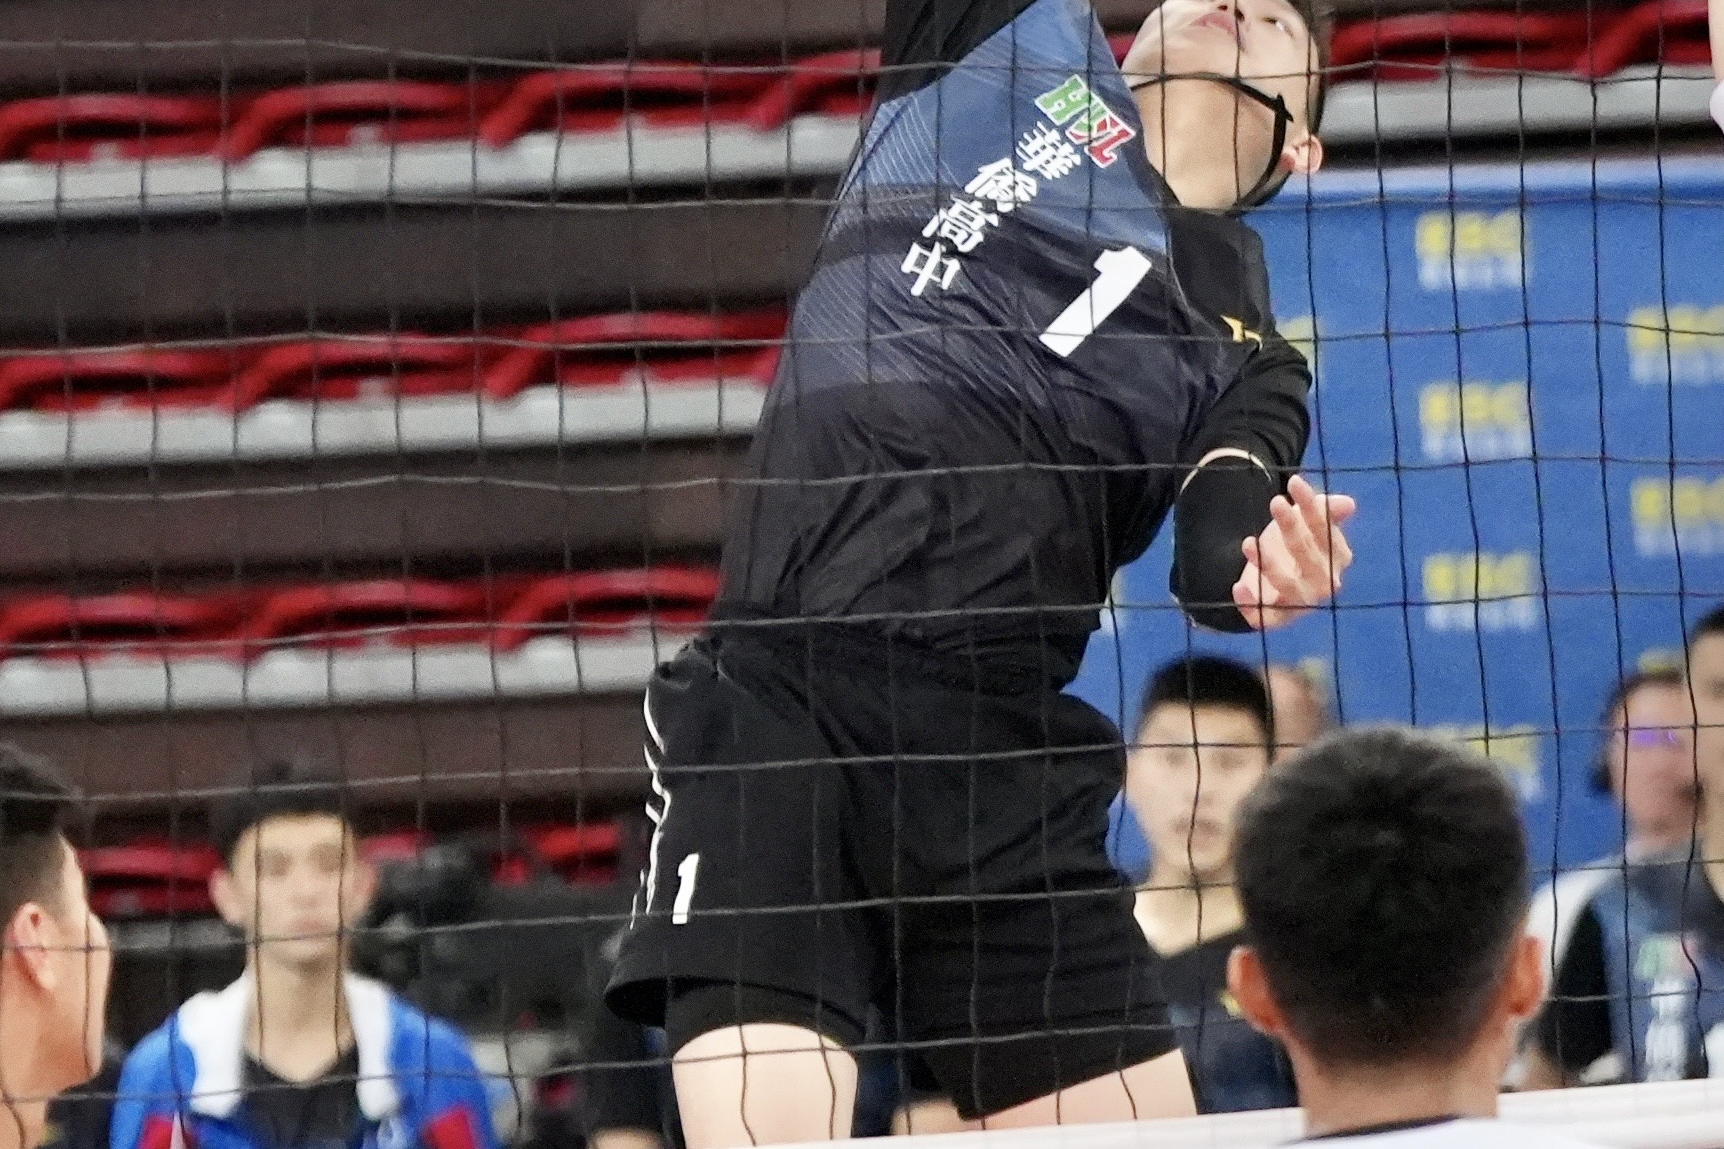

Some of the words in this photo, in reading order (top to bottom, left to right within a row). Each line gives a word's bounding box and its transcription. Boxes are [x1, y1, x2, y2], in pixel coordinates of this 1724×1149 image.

[901, 120, 1082, 297] 華僑高中
[1039, 246, 1152, 358] 1
[672, 852, 700, 925] 1
